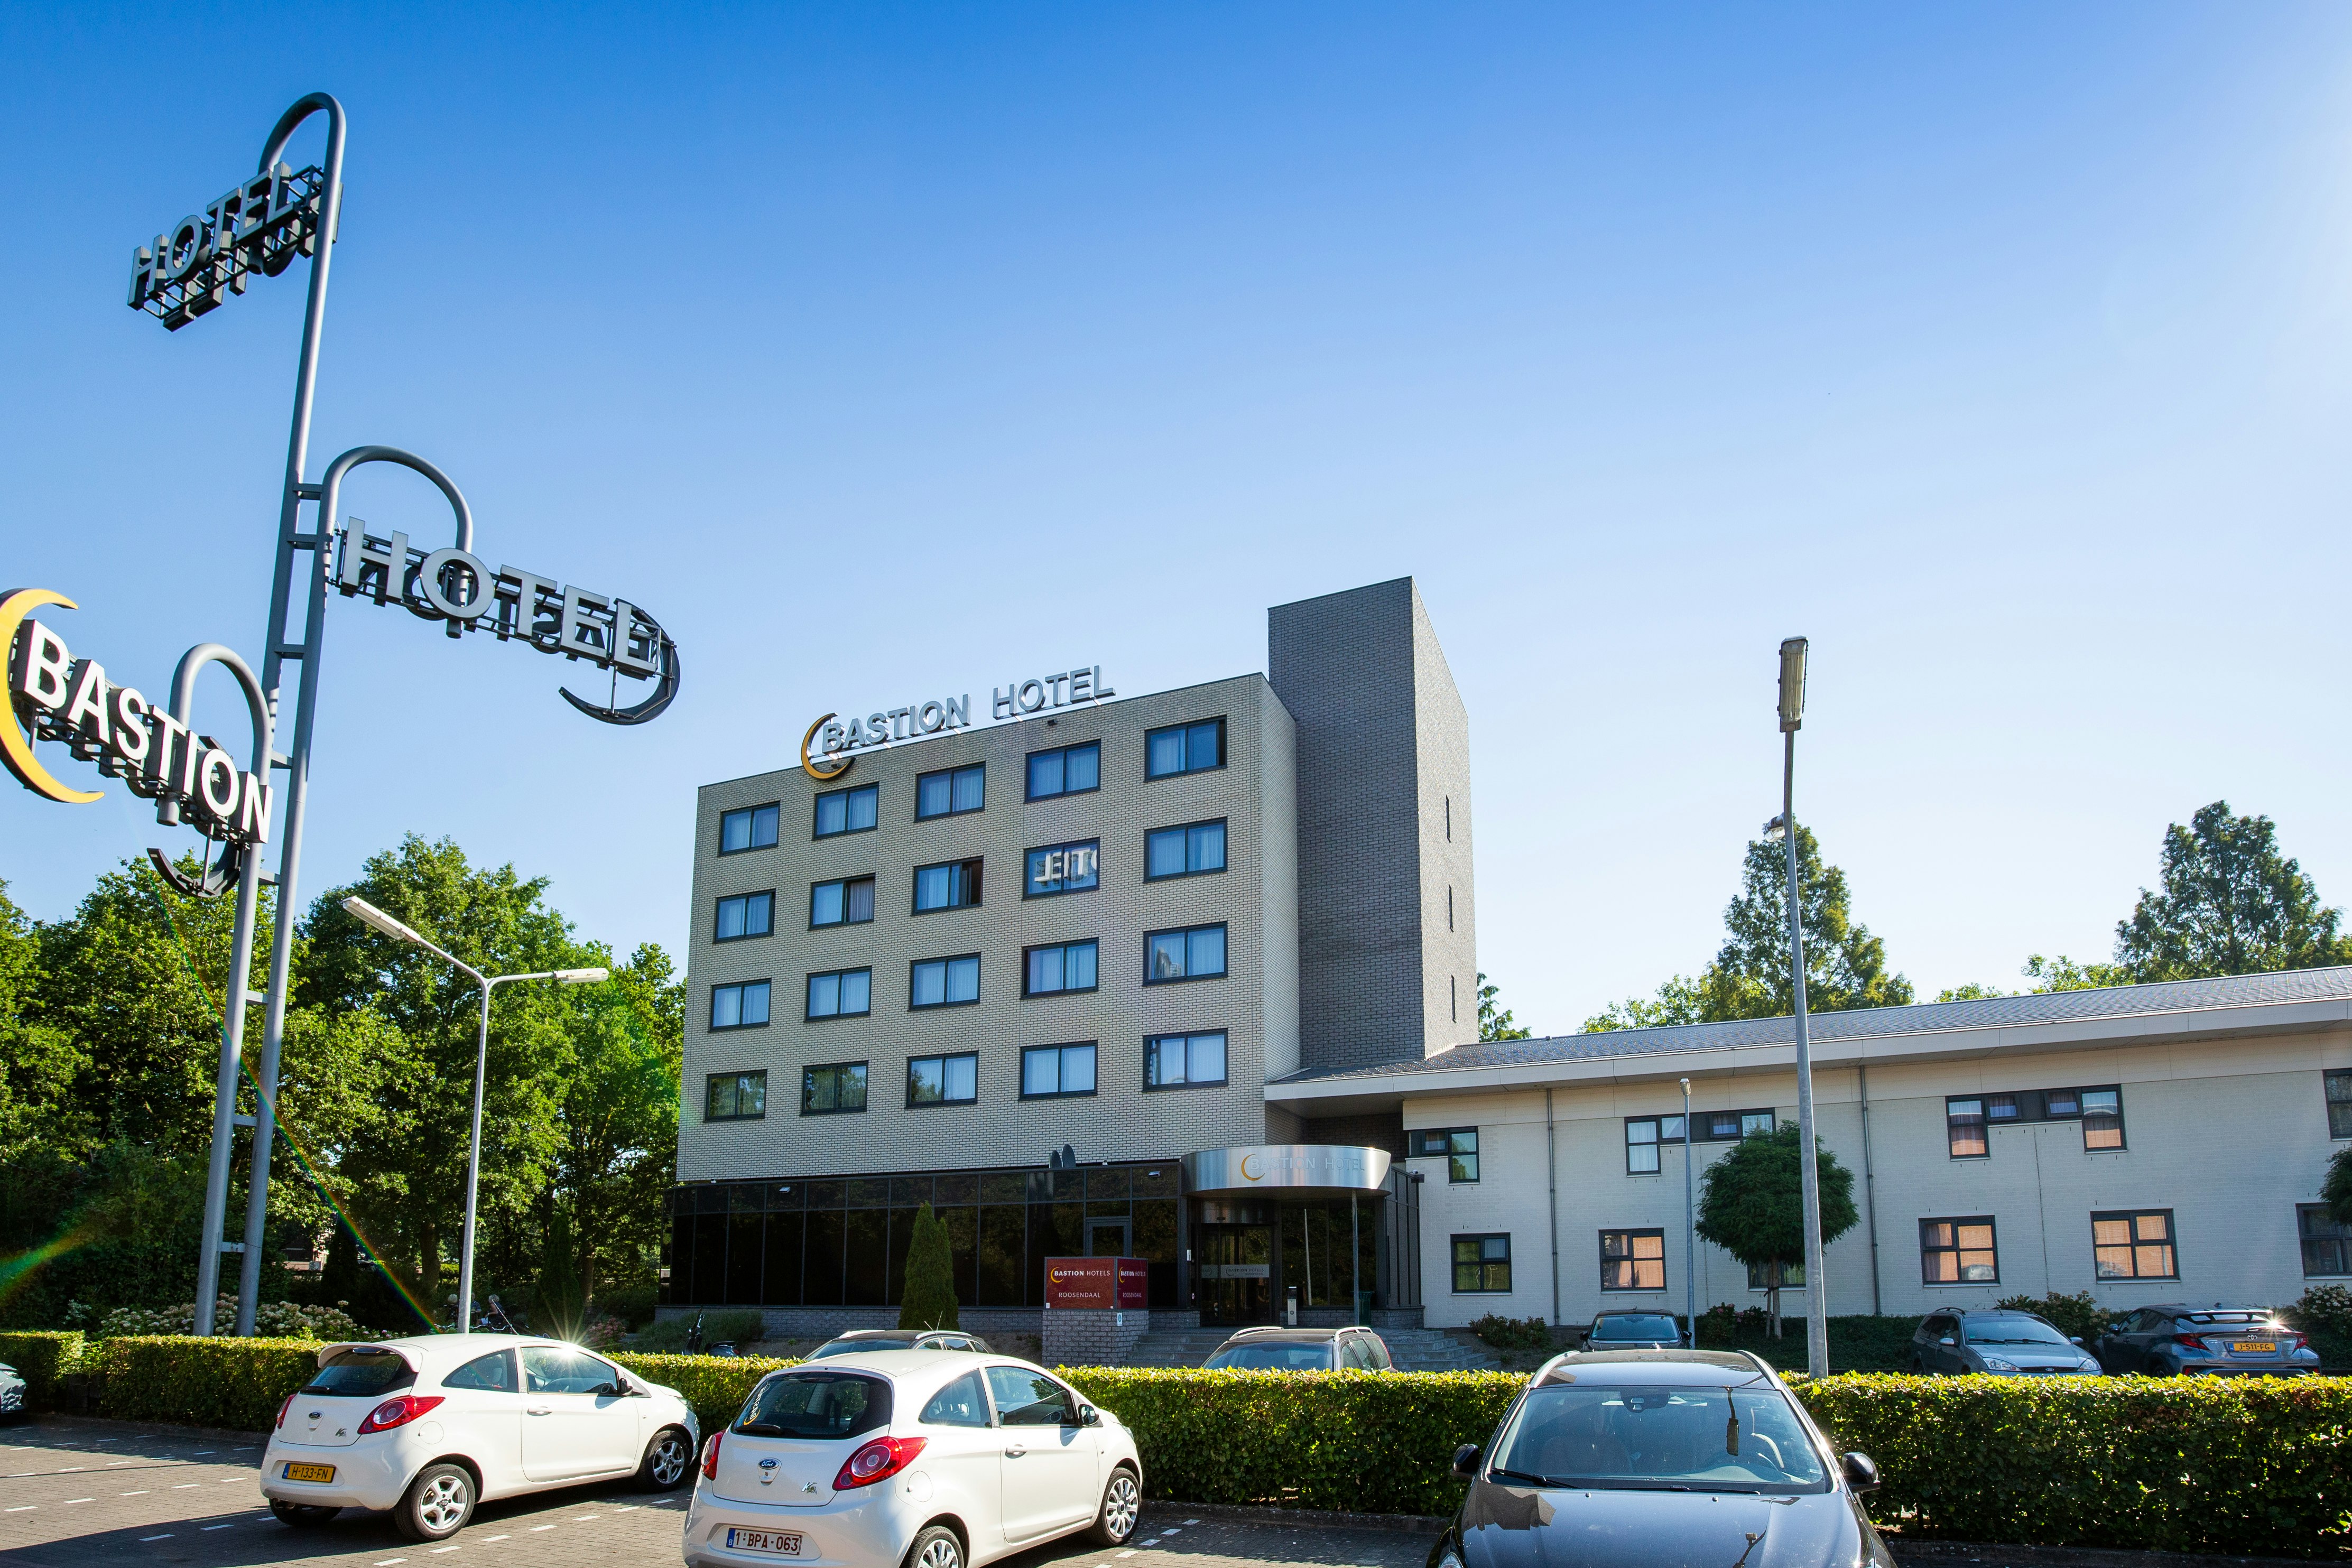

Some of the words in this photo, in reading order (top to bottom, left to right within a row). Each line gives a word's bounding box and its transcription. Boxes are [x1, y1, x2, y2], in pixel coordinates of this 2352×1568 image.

[127, 161, 299, 309] HOTEL
[340, 516, 658, 674] HOTEL
[20, 619, 274, 844] BASTION
[822, 694, 972, 755] BASTION
[993, 665, 1116, 720] HOTEL
[1250, 1157, 1316, 1170] BASTION
[1325, 1157, 1365, 1171] HOTEL
[291, 1466, 328, 1480] H-133-FN
[736, 1532, 799, 1552] 1-BPA-063
